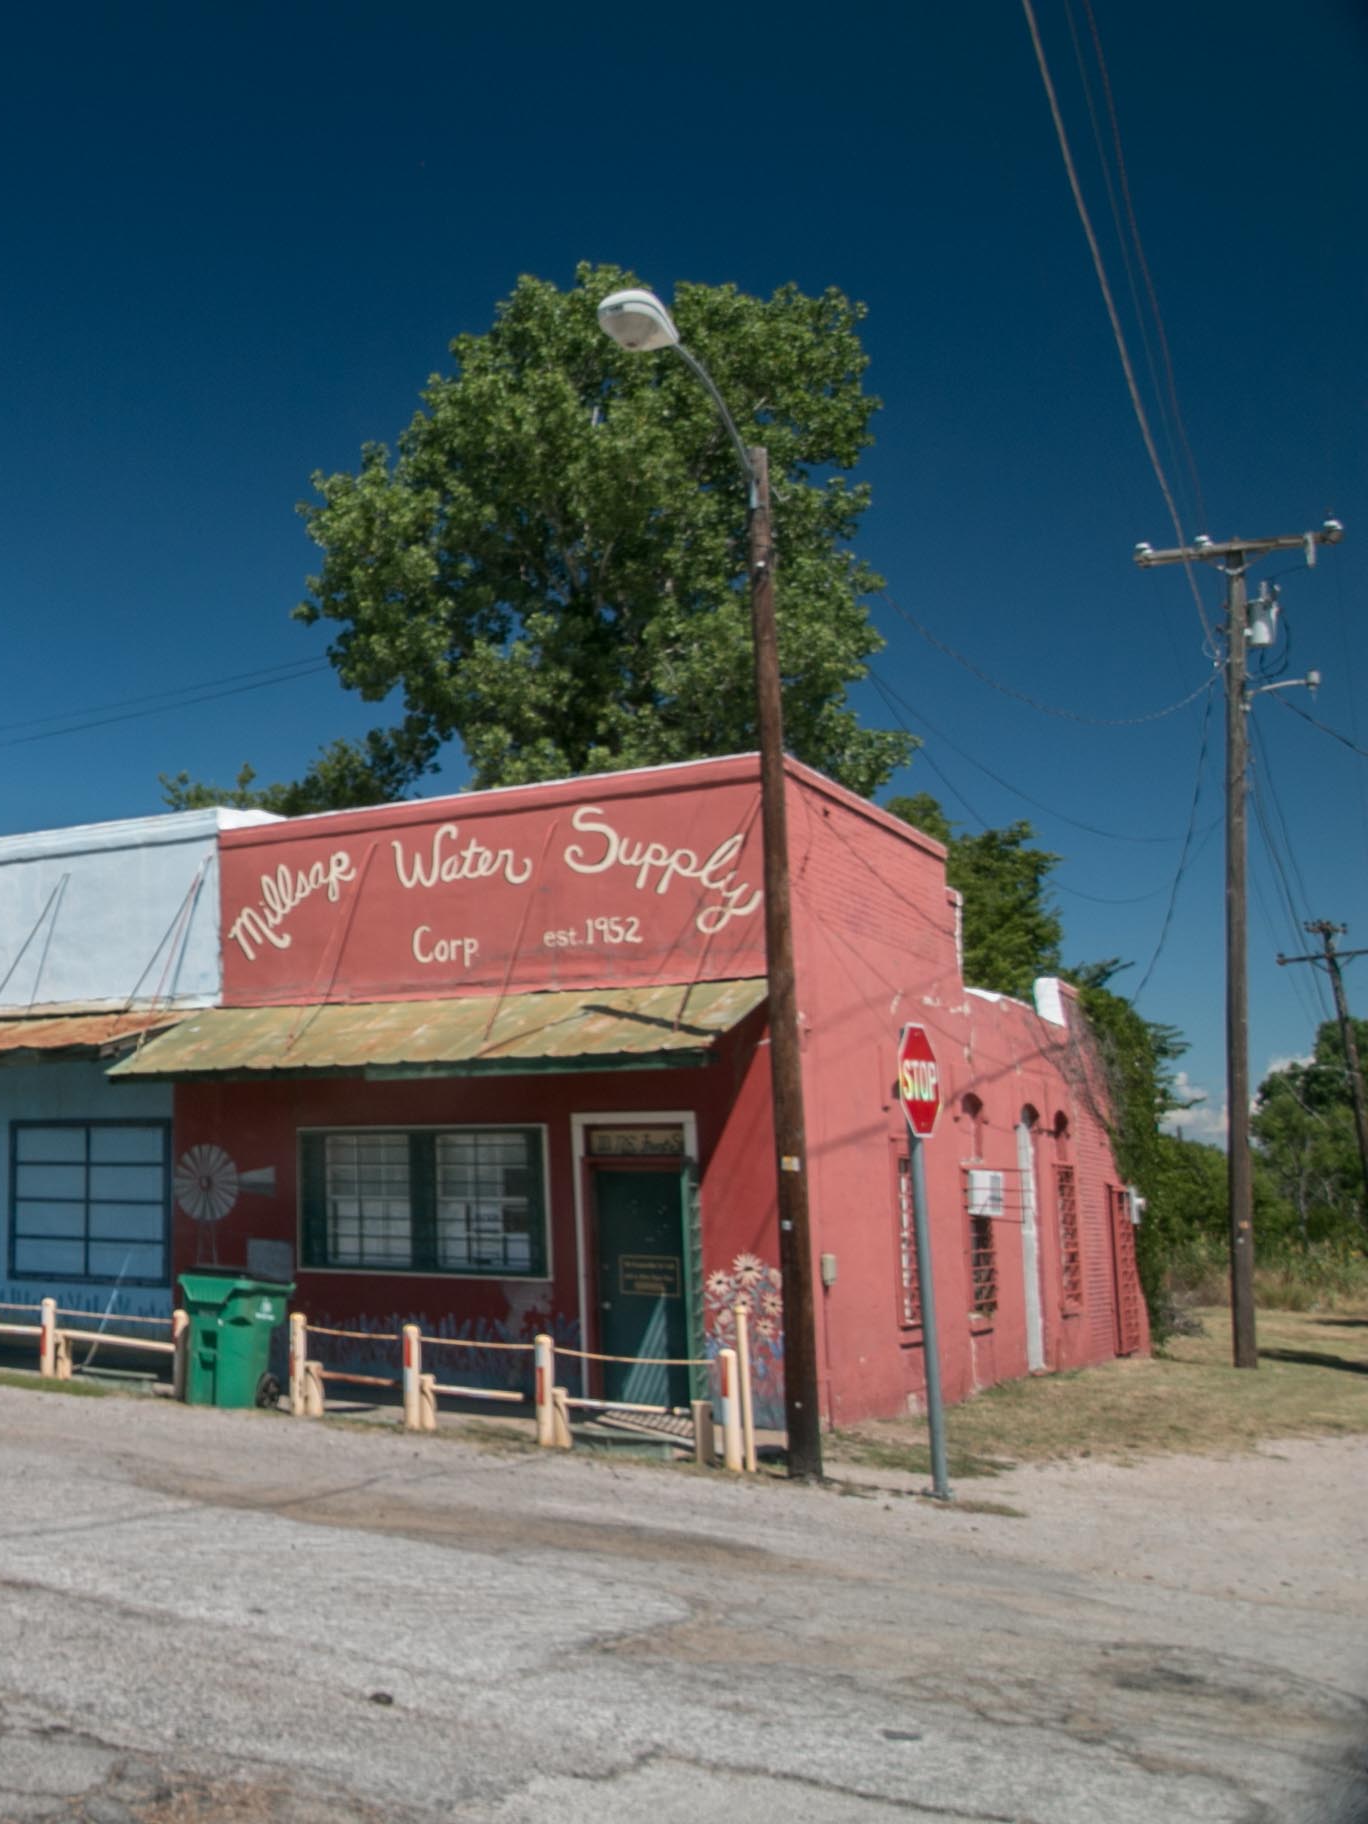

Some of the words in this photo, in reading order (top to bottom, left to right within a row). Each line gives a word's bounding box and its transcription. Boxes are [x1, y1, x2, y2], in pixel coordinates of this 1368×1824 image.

[228, 851, 357, 960] Millsap
[391, 823, 532, 889] Water
[563, 805, 764, 935] Supply
[412, 924, 480, 968] Corp
[902, 1059, 937, 1102] STOP
